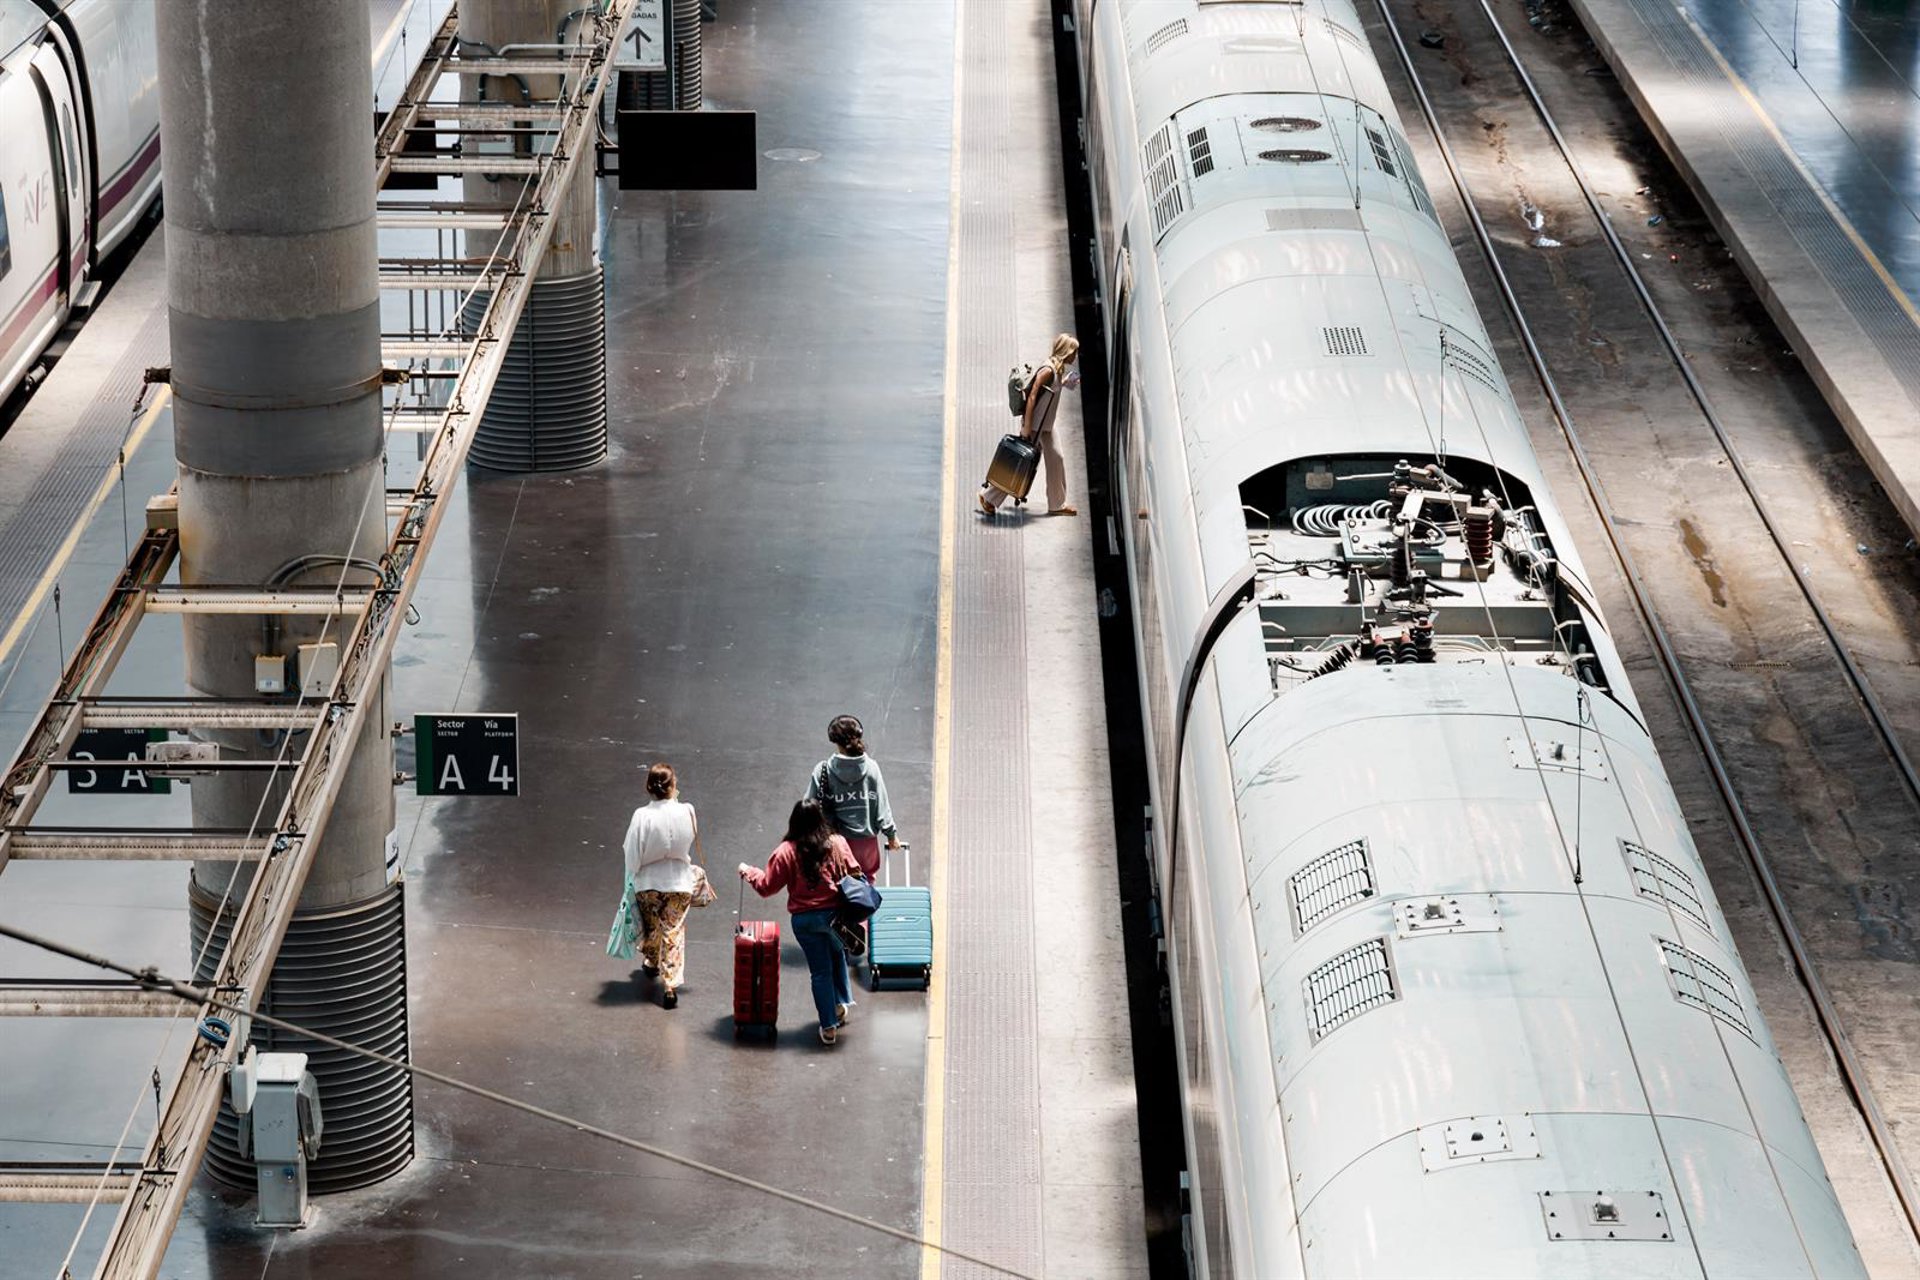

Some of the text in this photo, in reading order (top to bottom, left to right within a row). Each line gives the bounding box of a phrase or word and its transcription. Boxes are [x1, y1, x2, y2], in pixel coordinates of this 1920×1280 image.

[437, 720, 465, 728] Sector
[75, 751, 148, 788] 3 A
[438, 754, 514, 790] A 4
